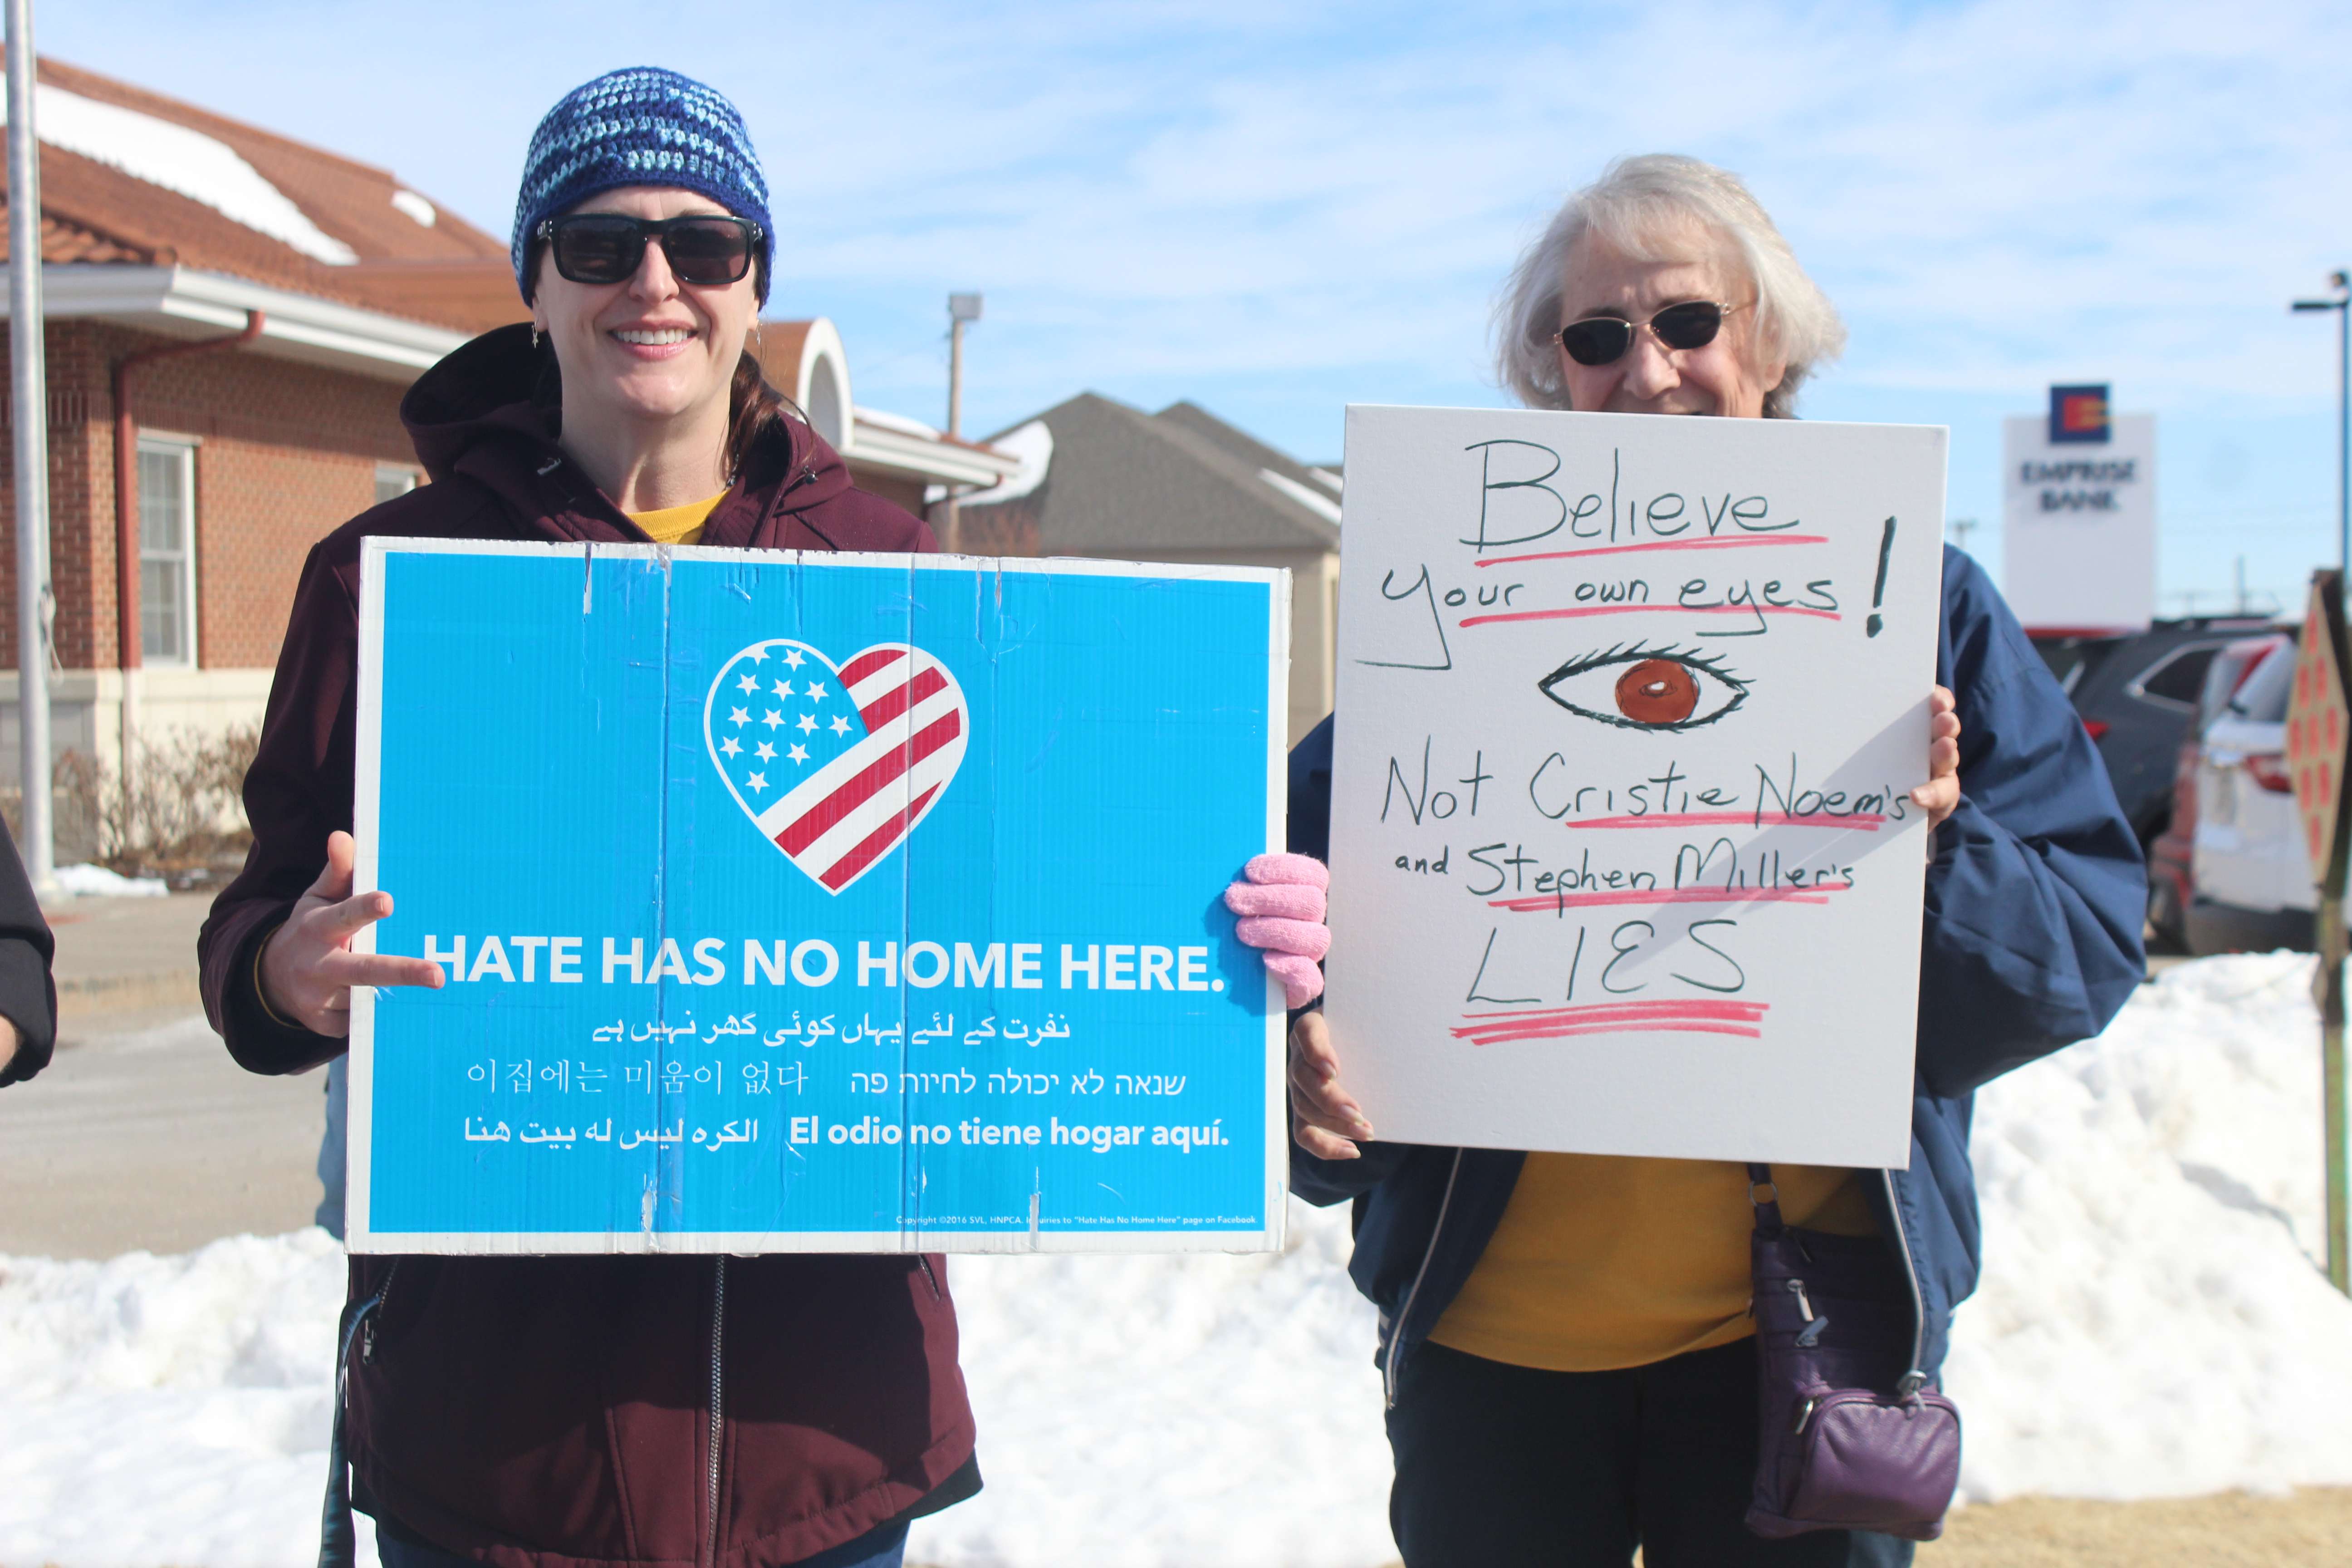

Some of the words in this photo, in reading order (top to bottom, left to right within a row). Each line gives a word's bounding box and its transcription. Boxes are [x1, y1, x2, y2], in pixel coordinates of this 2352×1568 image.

[2021, 461, 2135, 484] EMPRISE
[1458, 439, 1800, 554] Believe
[2041, 490, 2118, 513] BANK
[1574, 579, 1649, 603] own
[1380, 735, 1494, 826] Not
[1529, 752, 1738, 820] Cristie
[1754, 752, 1910, 829] Noem's
[1395, 845, 1449, 875] and
[1466, 843, 1656, 919] Stephen
[1674, 837, 1854, 893] Miller's
[424, 935, 583, 983] HATE
[602, 937, 725, 986] HAS
[744, 939, 839, 987] NO
[858, 941, 1043, 989] HOME
[1061, 944, 1225, 992] HERE.
[1466, 919, 1744, 1004] LIES
[1003, 1013, 1071, 1047] نفرت
[624, 1060, 722, 1095] 미움이
[742, 1061, 809, 1095] 없다
[851, 1073, 888, 1094] פה
[899, 1067, 976, 1095] לחיות
[988, 1067, 1060, 1095] יכולה
[1071, 1068, 1104, 1095] לא
[1116, 1075, 1186, 1096] שנאה
[465, 1117, 511, 1142] هنا
[519, 1122, 576, 1150] بيت
[585, 1117, 612, 1142] له
[619, 1117, 684, 1150] ليس
[692, 1118, 758, 1152] الكره
[790, 1116, 818, 1145] El
[828, 1116, 902, 1145] odio
[911, 1124, 951, 1145] no
[958, 1117, 1042, 1145] tiene
[1051, 1117, 1145, 1153] hogar
[1152, 1119, 1229, 1154] aquí.
[896, 1215, 937, 1226] Copyright
[970, 1216, 987, 1225] SVL,
[1026, 1216, 1061, 1224] Iuiries
[1117, 1216, 1129, 1224] No
[1182, 1217, 1204, 1226] page
